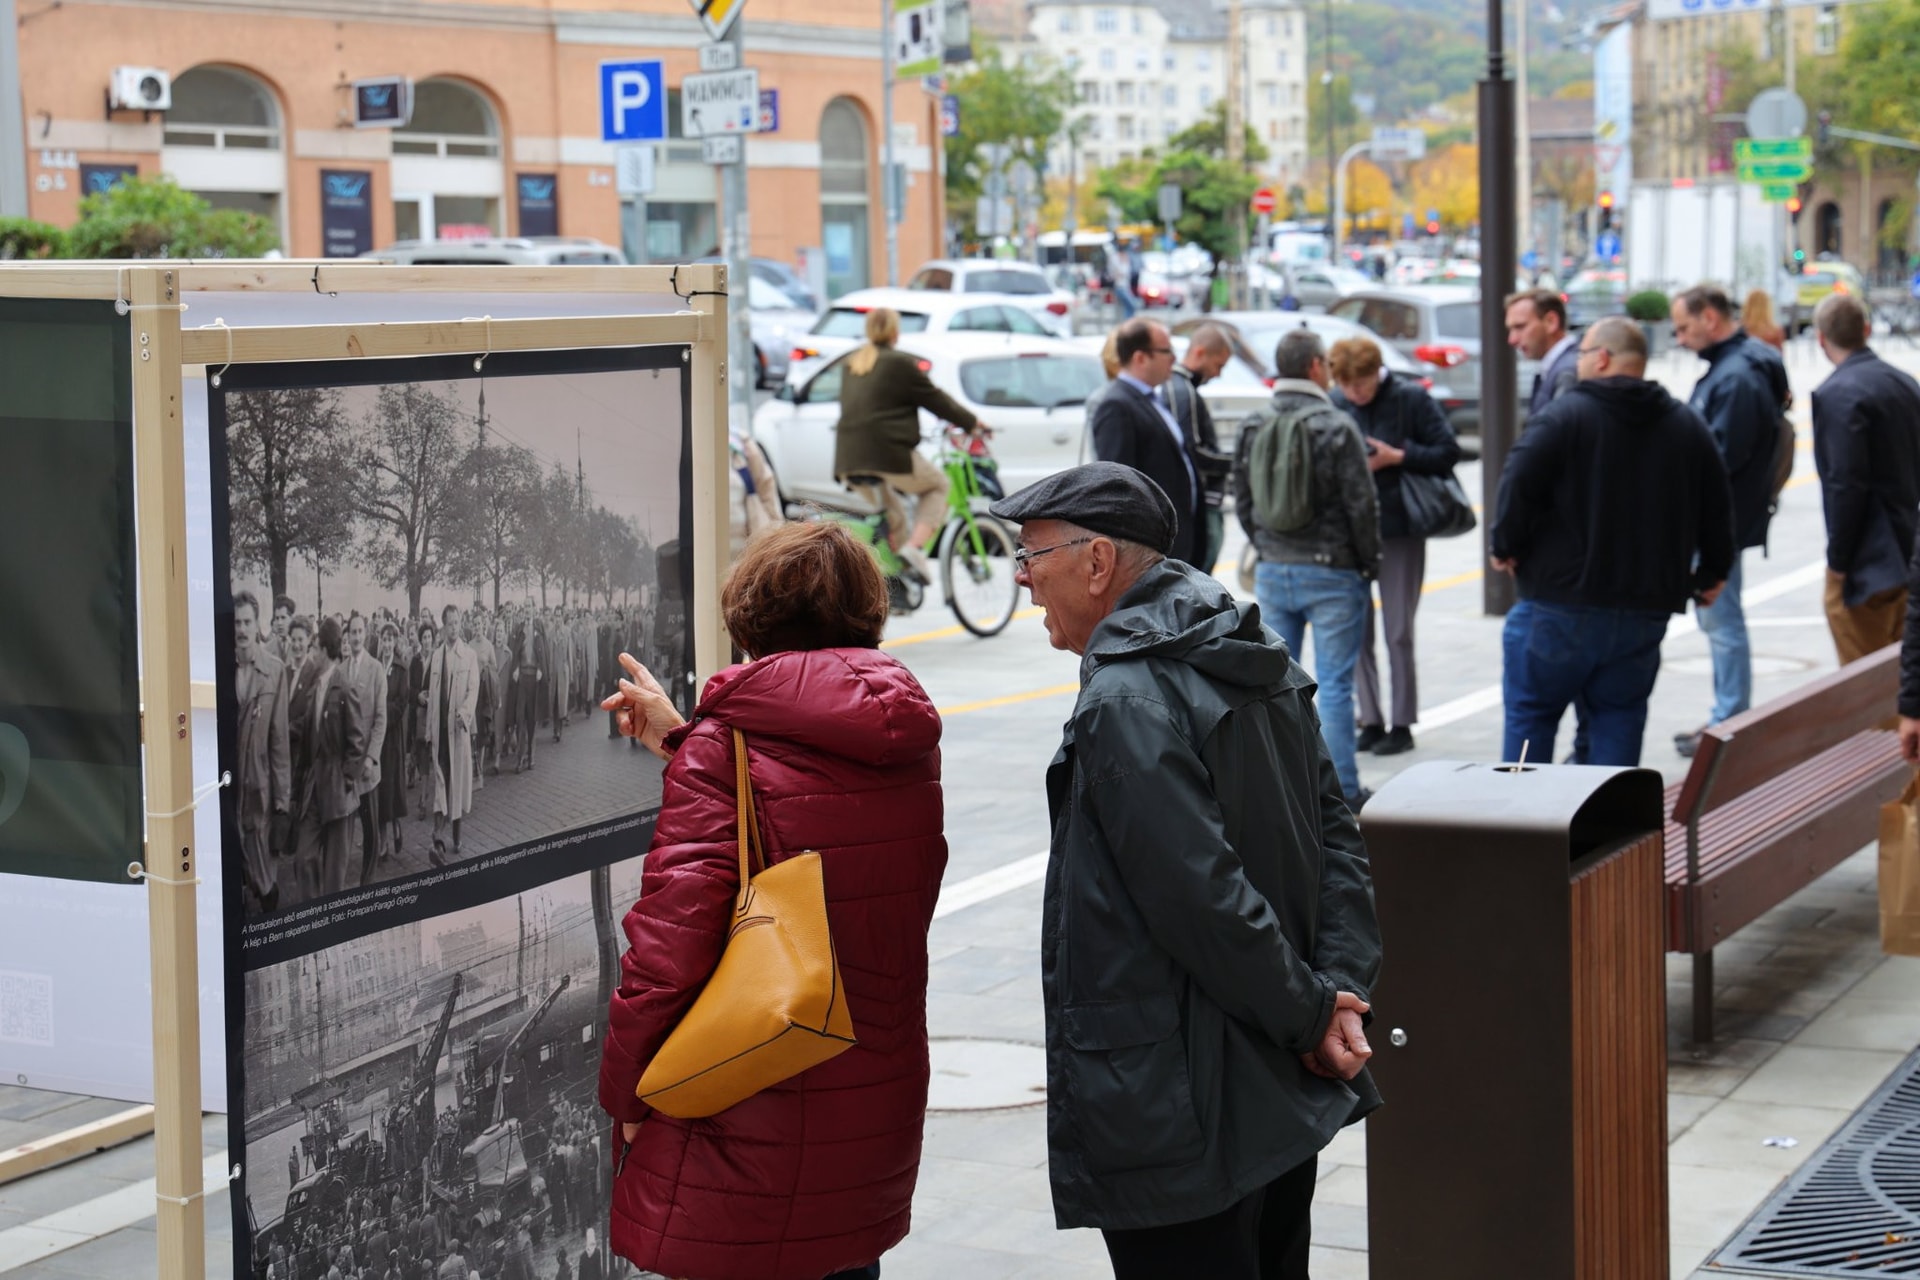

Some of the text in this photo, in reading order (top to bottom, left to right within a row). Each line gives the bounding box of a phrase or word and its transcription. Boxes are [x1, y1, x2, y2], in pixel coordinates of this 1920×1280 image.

[612, 70, 651, 134] P
[685, 74, 755, 104] MAMMUT
[241, 925, 248, 934] A
[248, 917, 283, 933] forradalom
[296, 906, 322, 920] eseménye
[323, 903, 328, 911] a
[328, 890, 374, 909] szabadságukért
[391, 879, 418, 895] egyetemi
[419, 873, 444, 888] hallgatók
[242, 940, 249, 949] A
[249, 937, 262, 948] kép
[262, 936, 268, 944] a
[268, 932, 284, 943] Bem
[284, 923, 311, 938] rakparton
[331, 912, 346, 923] Fotó:
[396, 894, 419, 906] György
